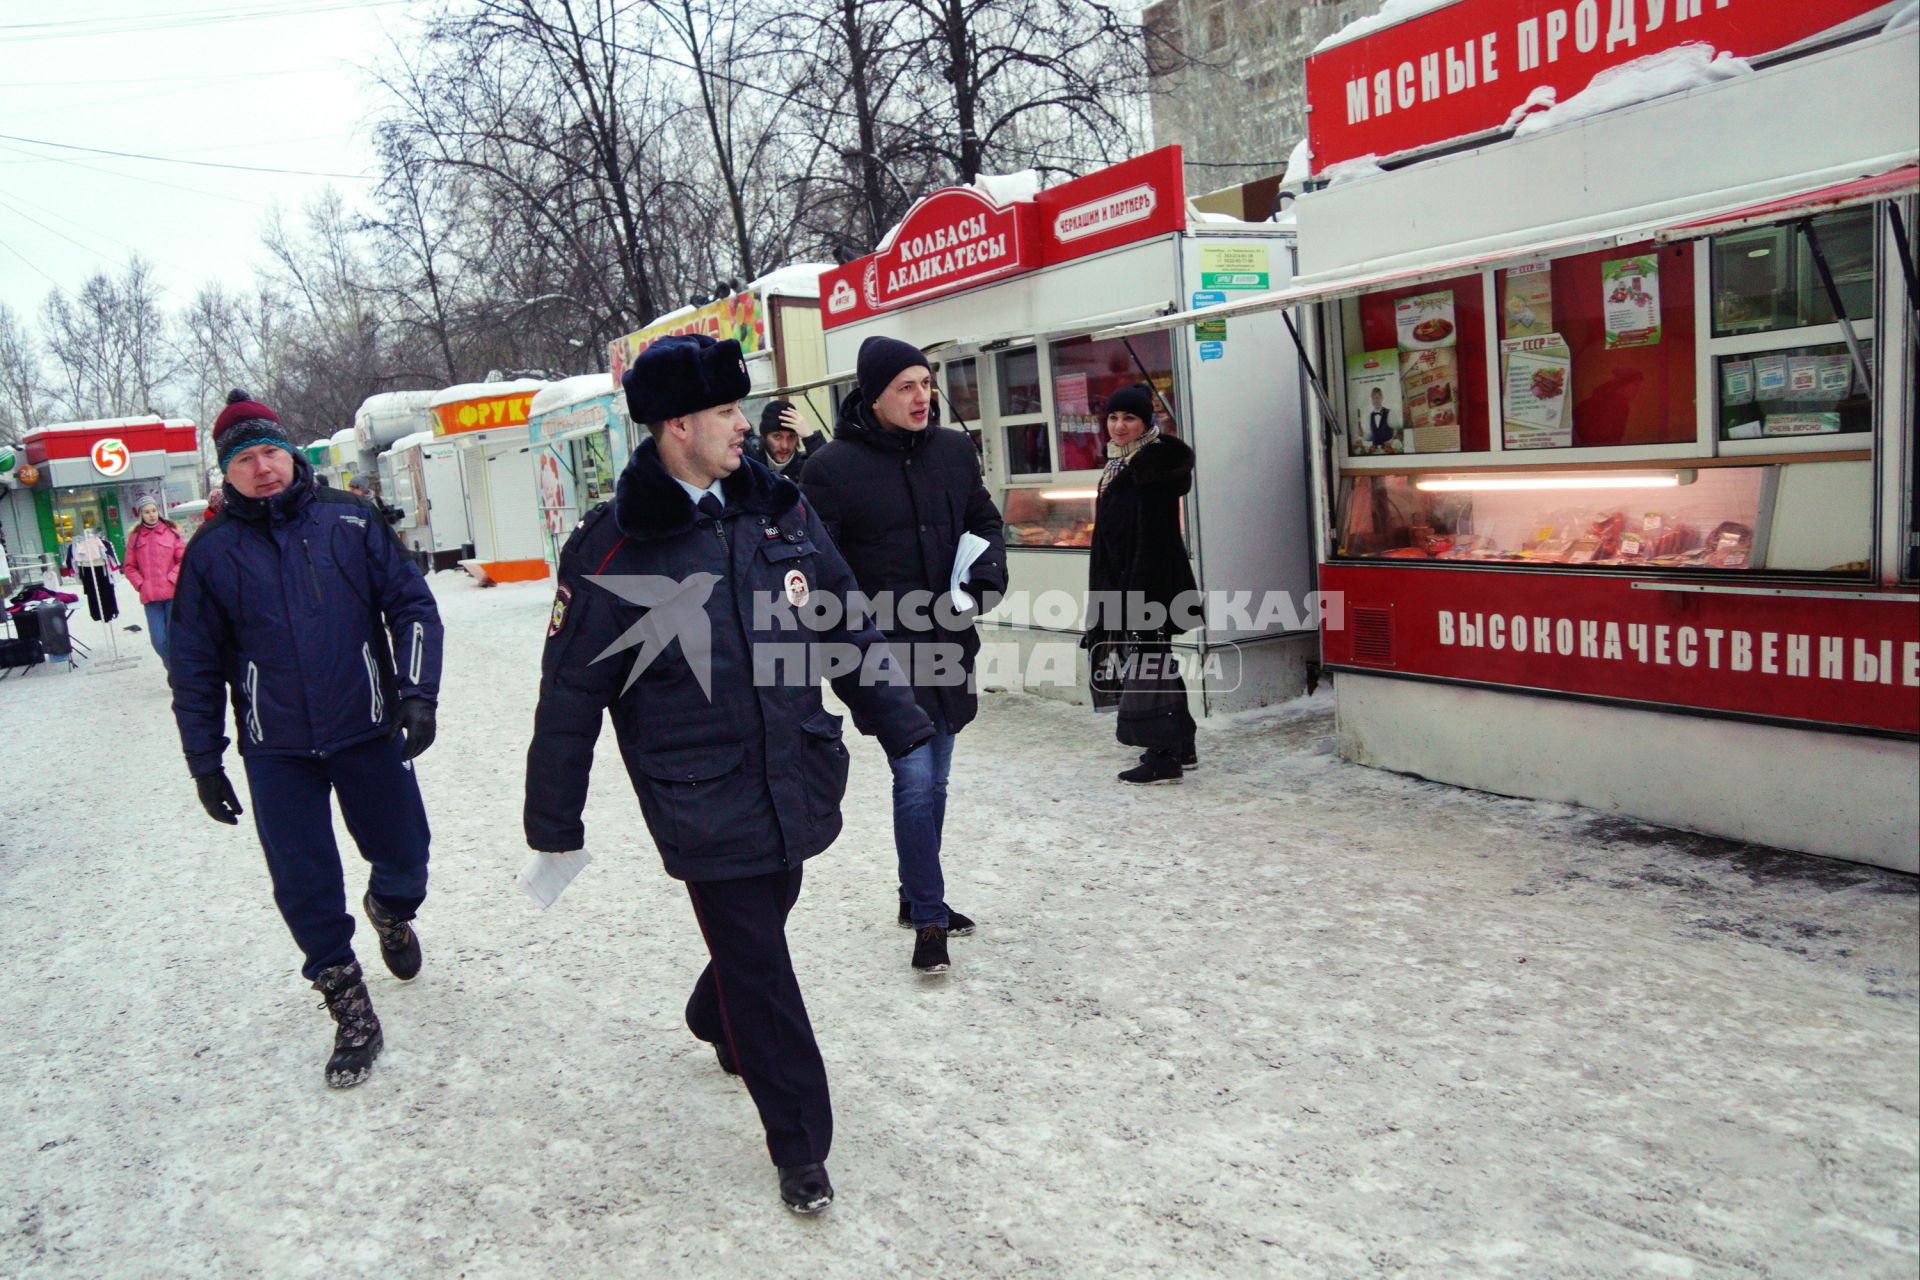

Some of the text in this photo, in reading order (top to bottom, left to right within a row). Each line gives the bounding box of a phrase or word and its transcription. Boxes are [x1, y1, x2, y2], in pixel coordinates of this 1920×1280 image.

[1346, 32, 1500, 125] МЯСНЫЕ
[899, 213, 987, 263] КОЛБАСЫ
[1060, 208, 1100, 233] ЧЕРКАШИН
[1102, 206, 1108, 221] И
[886, 233, 1007, 294] ДЕЛИКАТЕСЫ
[1522, 337, 1546, 351] СССР
[458, 397, 531, 428] ФРУК
[1438, 610, 1919, 687] ВЫСОКОКАЧЕСТВЕННЫЕ
